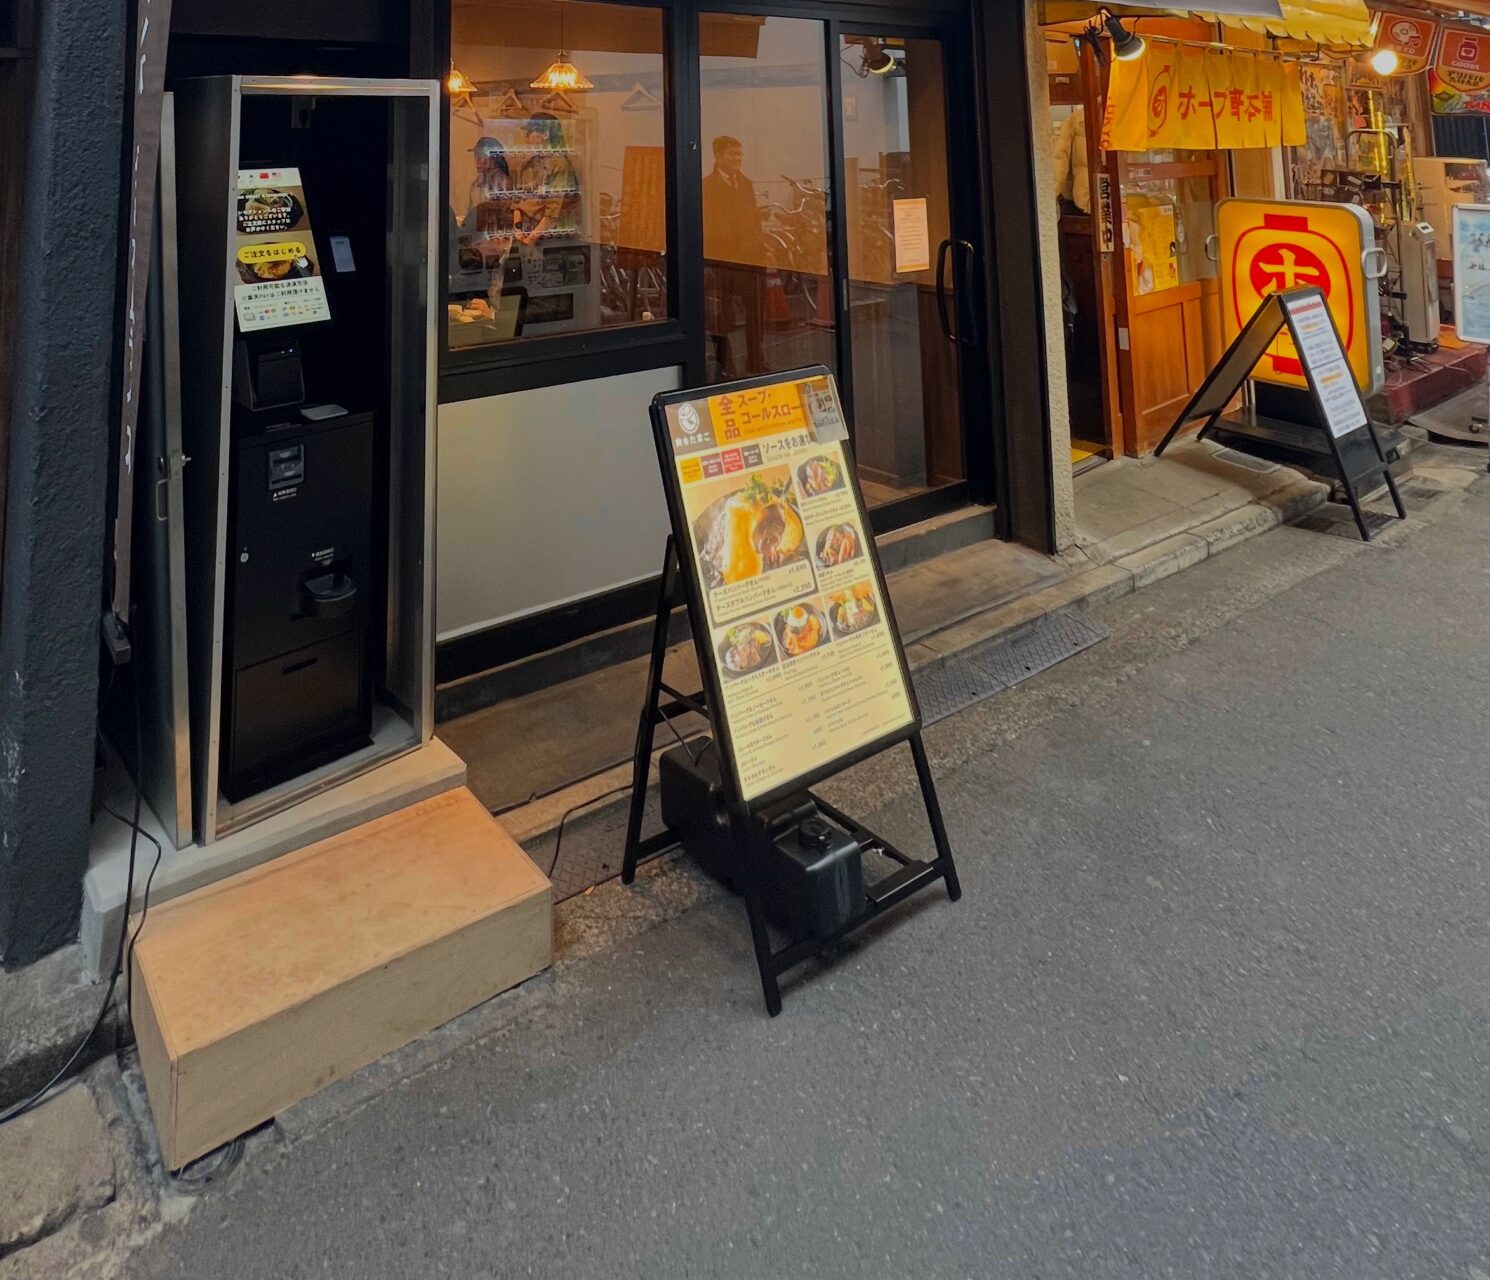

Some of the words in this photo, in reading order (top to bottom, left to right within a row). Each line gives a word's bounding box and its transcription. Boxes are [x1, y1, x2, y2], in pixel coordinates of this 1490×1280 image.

[1451, 60, 1480, 71] GOODS
[244, 246, 301, 259] ご注文をはじめる
[718, 395, 741, 441] 全品
[741, 403, 803, 425] コールスロー
